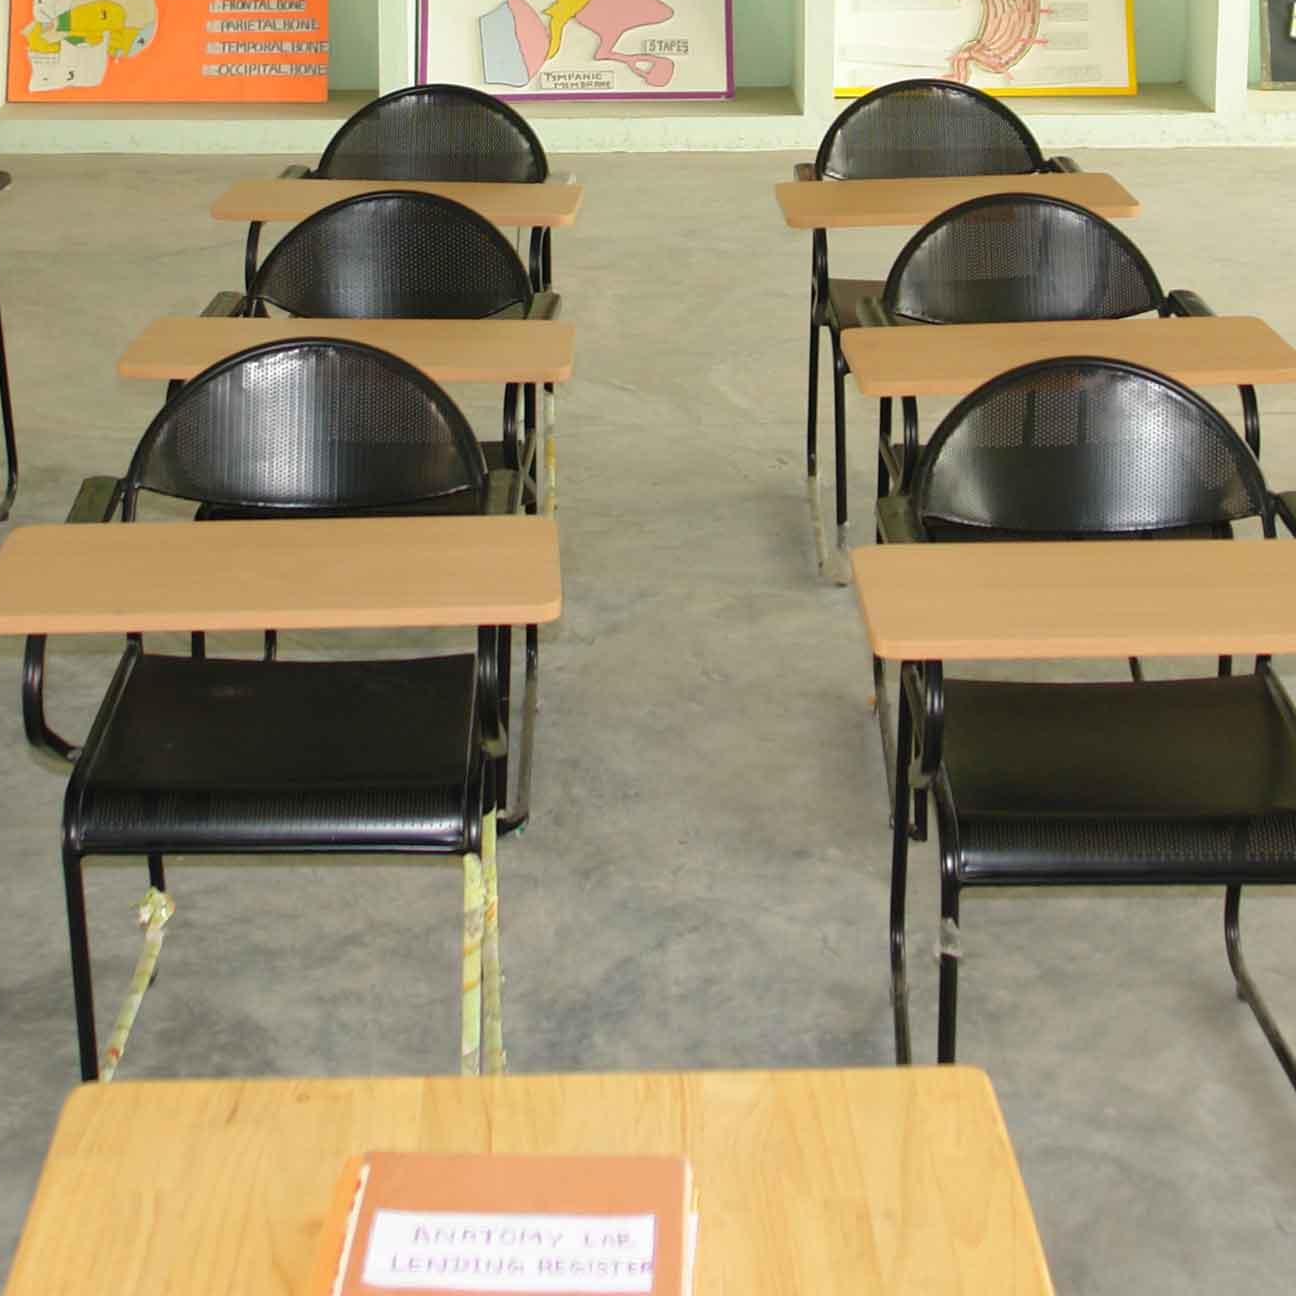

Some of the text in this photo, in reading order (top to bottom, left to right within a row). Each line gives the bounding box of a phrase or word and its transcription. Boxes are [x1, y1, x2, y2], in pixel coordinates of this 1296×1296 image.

[221, 0, 272, 11] FRONTAL
[221, 19, 320, 32] PARIETAL BONE
[220, 40, 329, 53] TEMPORAL BONE
[218, 64, 329, 76] OCCIPITAL BONE
[412, 1224, 564, 1248] ANATOMY
[390, 1252, 653, 1277] LENDING REGISTER
